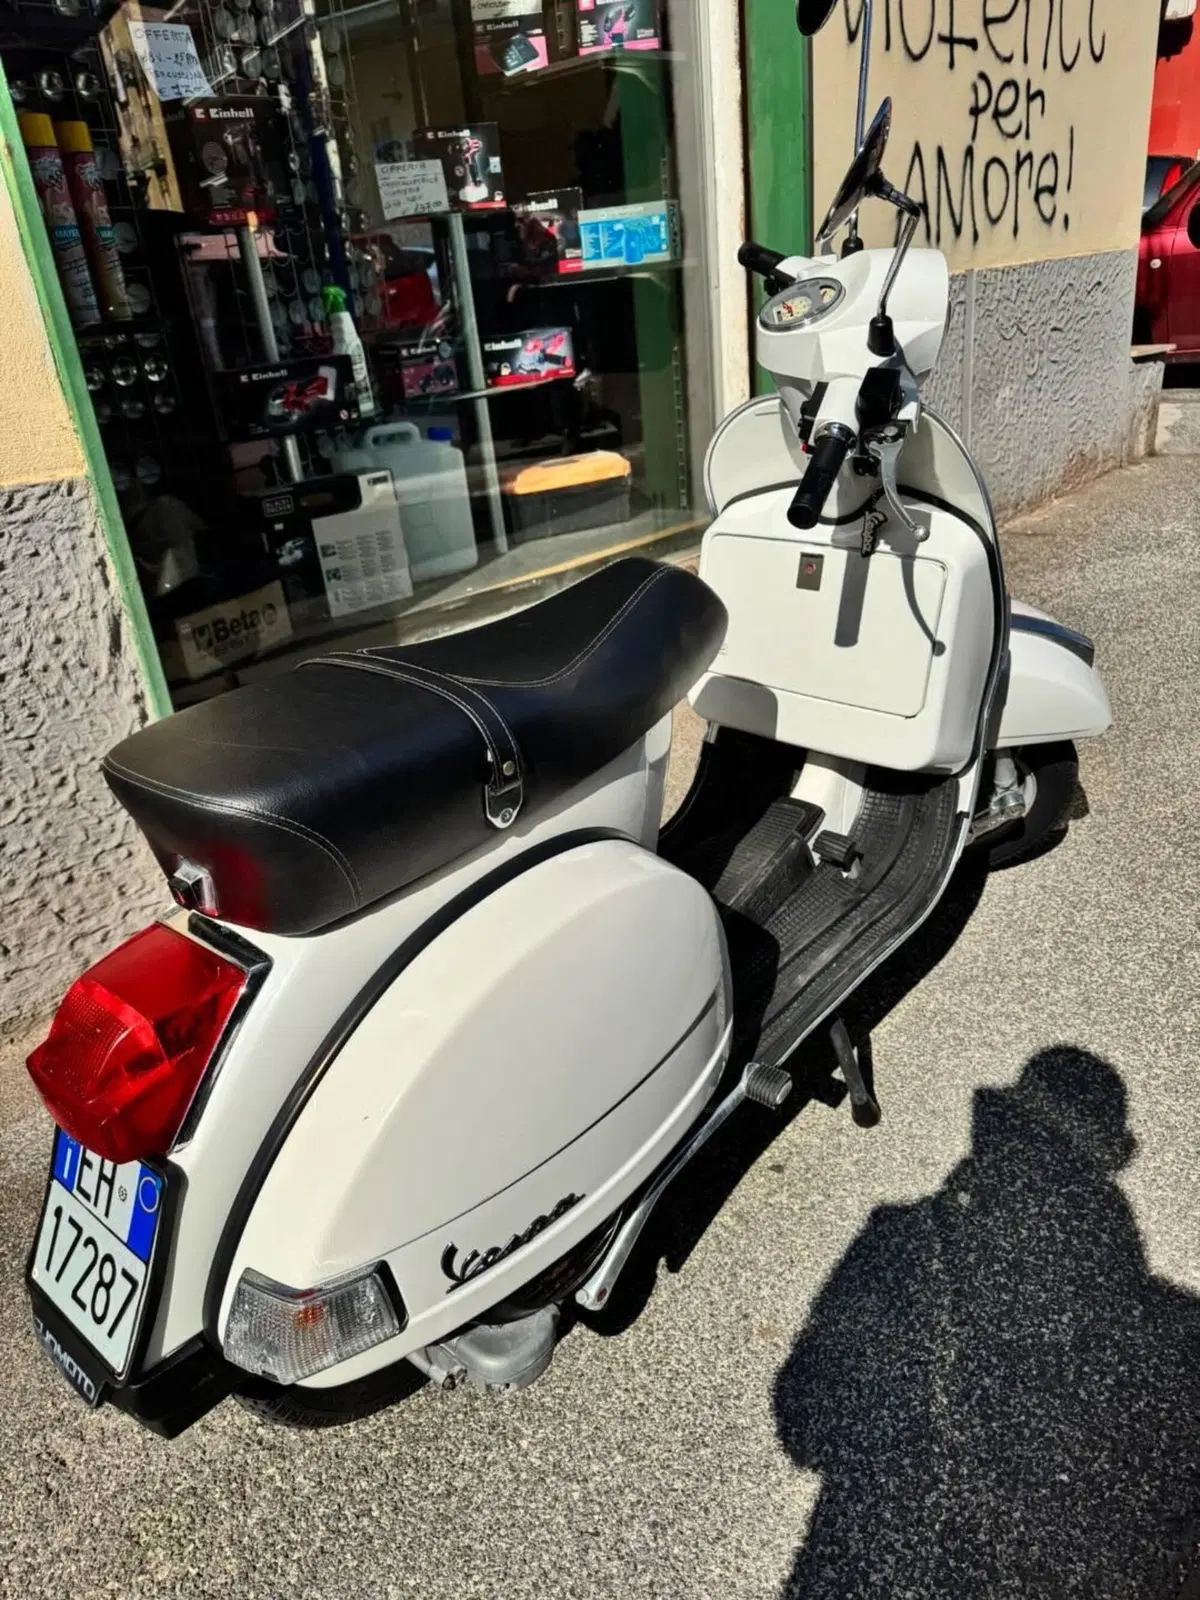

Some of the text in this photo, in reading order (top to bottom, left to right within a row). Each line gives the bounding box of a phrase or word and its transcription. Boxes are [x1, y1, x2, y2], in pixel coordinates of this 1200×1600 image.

[209, 107, 254, 119] Einhell
[969, 70, 1046, 143] per
[251, 369, 288, 381] Einhell
[212, 609, 260, 643] Beta
[76, 1147, 117, 1218] EH
[45, 1205, 138, 1338] 17287
